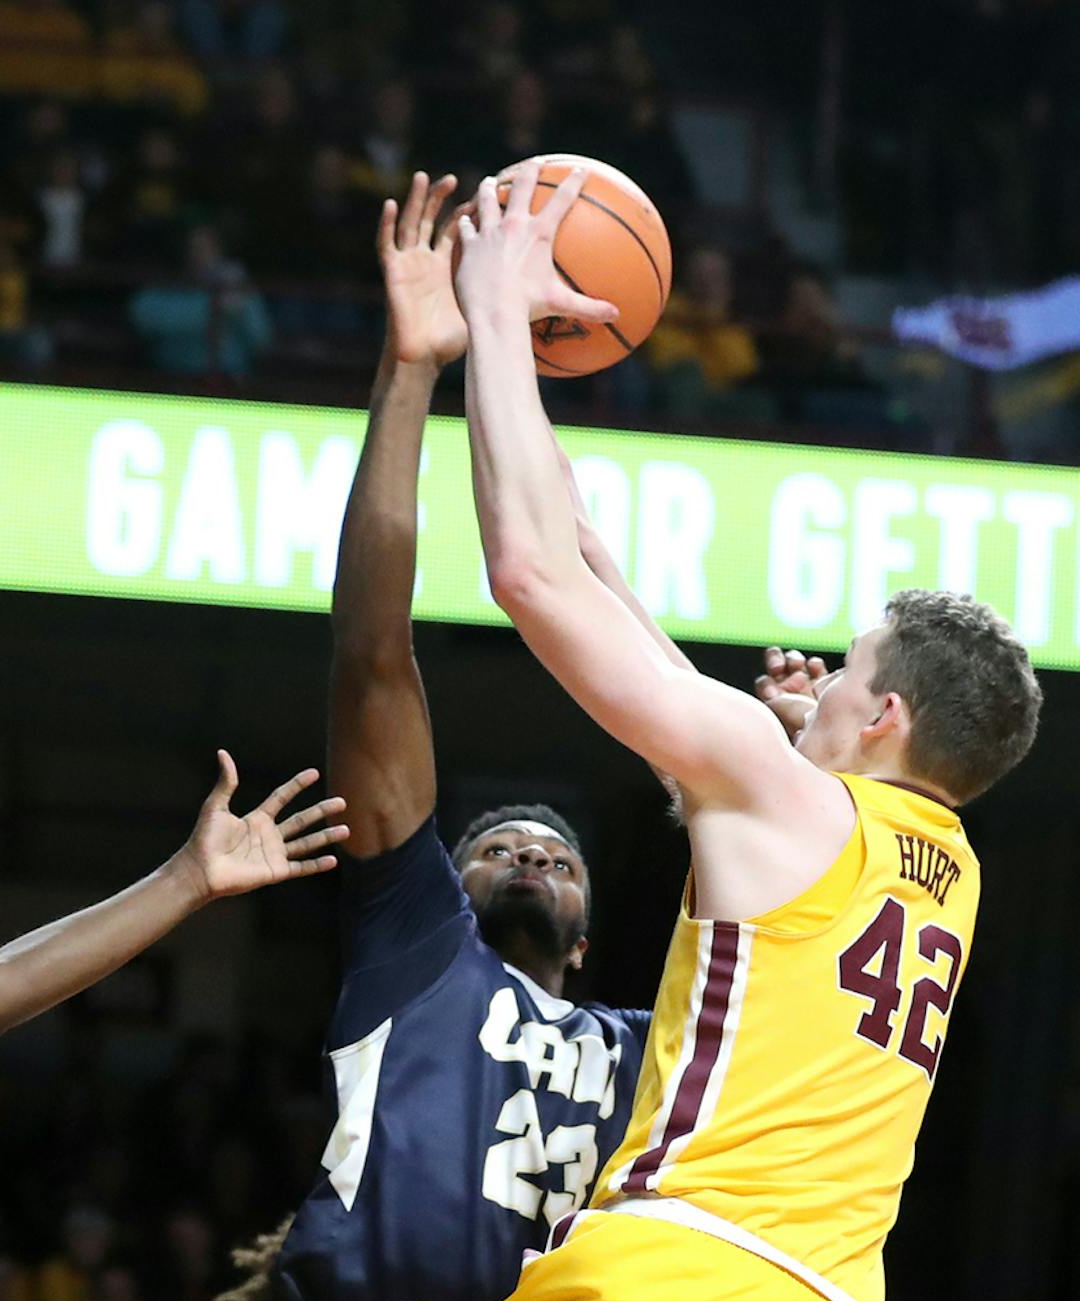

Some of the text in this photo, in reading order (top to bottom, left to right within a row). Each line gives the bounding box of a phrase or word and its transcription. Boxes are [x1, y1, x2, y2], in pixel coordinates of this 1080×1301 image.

[86, 418, 429, 600] GAM
[768, 470, 1080, 647] GETT
[894, 833, 962, 908] HURT
[837, 896, 963, 1085] 42
[481, 1088, 600, 1227] 23
